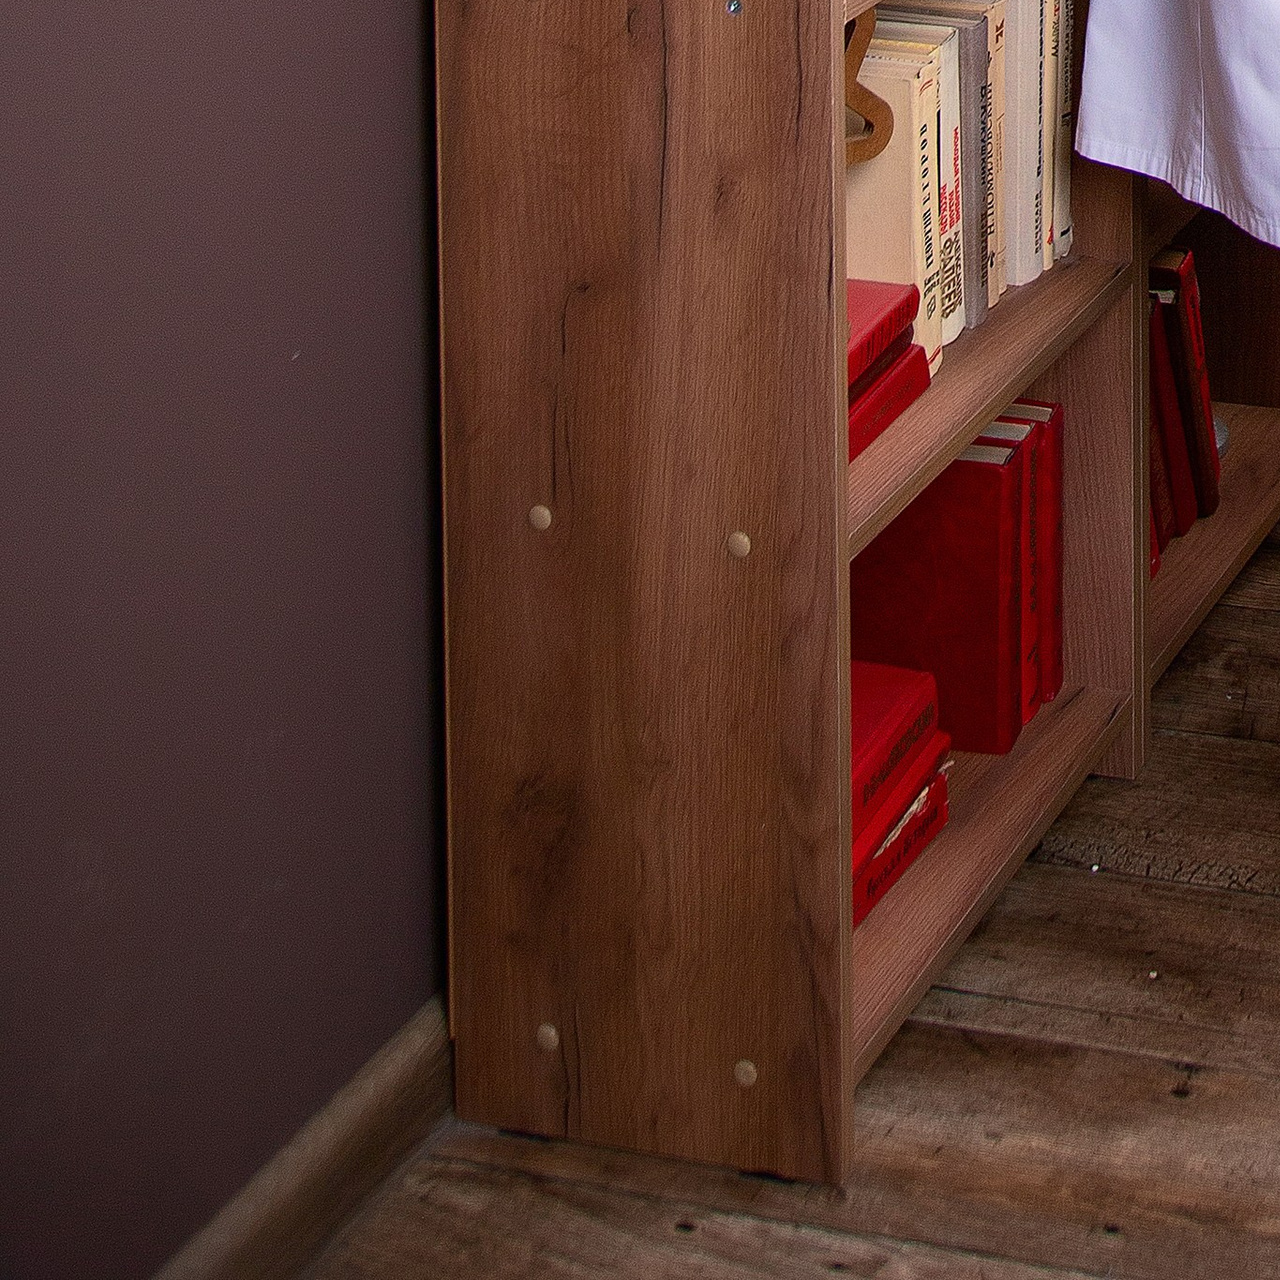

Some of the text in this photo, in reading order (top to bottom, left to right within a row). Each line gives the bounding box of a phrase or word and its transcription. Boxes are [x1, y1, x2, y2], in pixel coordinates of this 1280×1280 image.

[920, 123, 932, 205] ЕГОРОВ
[922, 207, 934, 269] ГЕОРГИЙ
[939, 184, 948, 238] РАССКАЗЫ
[940, 238, 957, 320] ФАДЕЕВ
